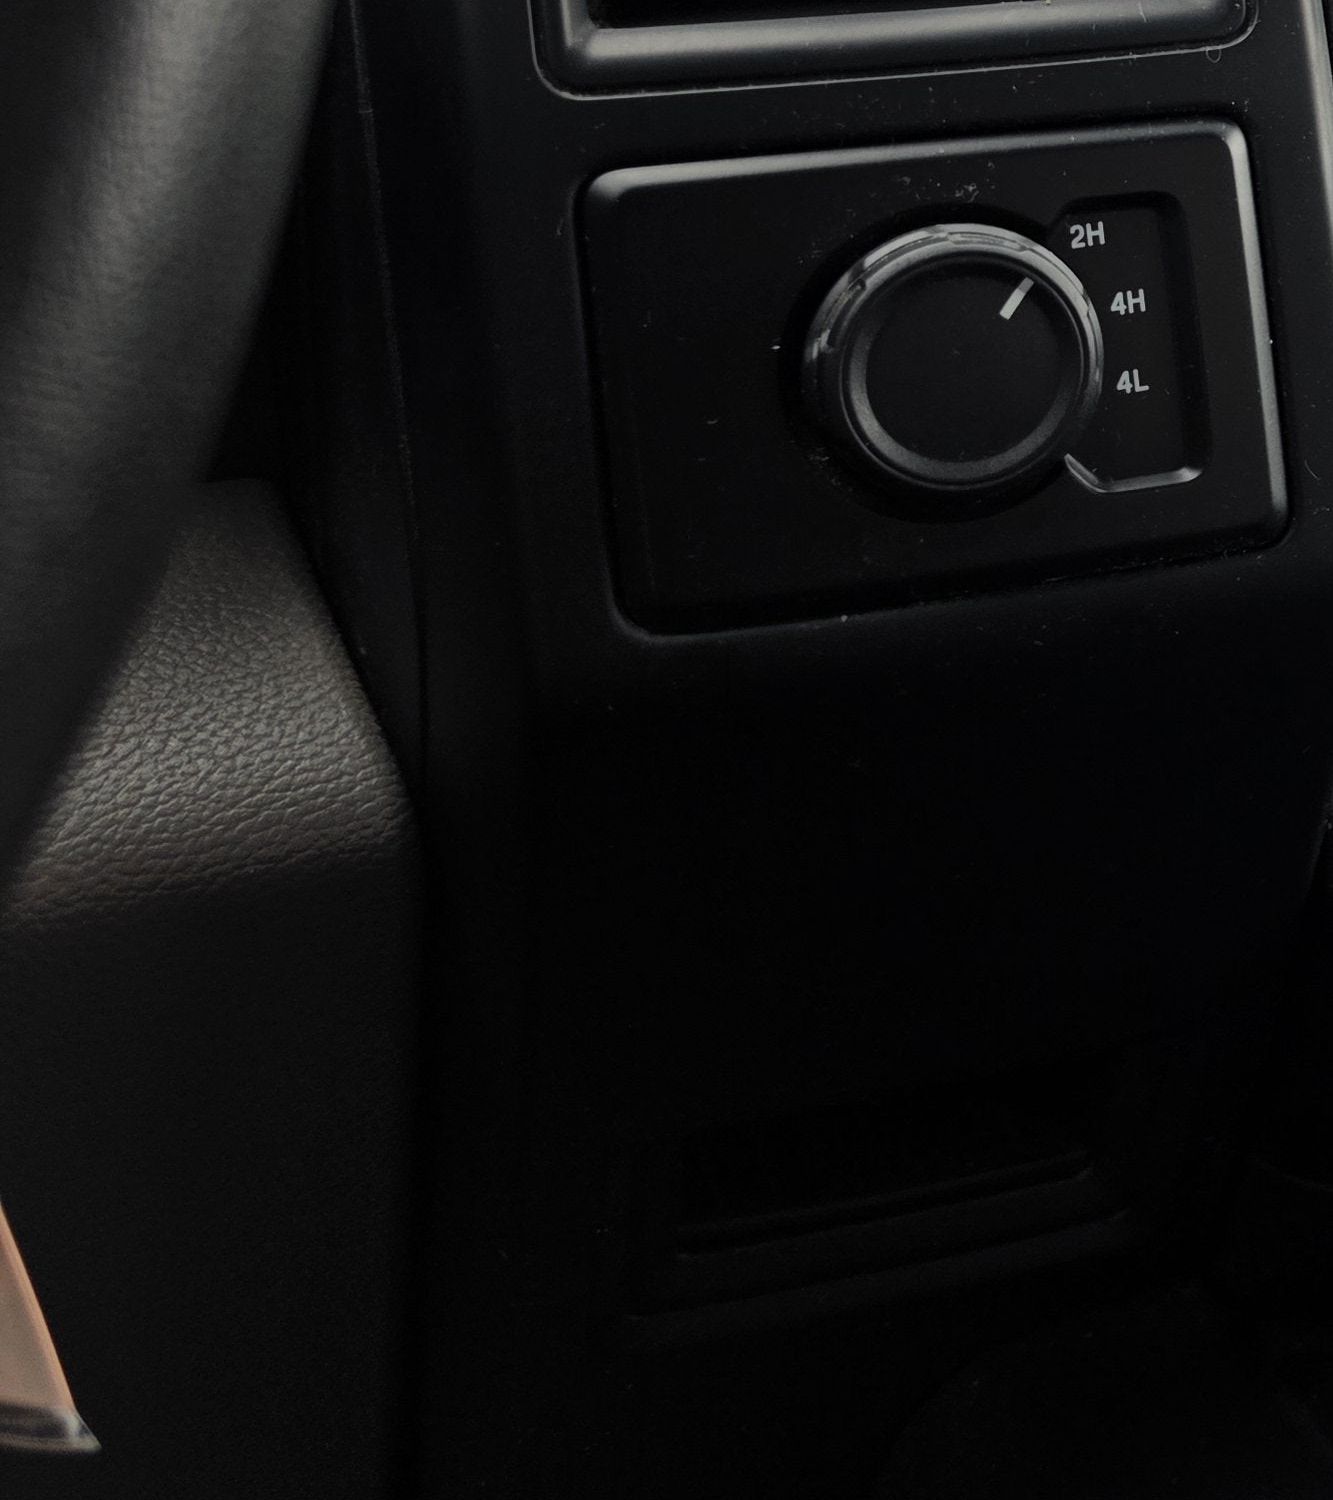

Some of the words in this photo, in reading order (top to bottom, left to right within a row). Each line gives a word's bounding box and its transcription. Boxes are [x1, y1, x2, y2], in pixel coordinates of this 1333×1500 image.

[1069, 220, 1106, 250] 2H
[1110, 288, 1147, 316] 4H
[1116, 368, 1150, 395] 4L
